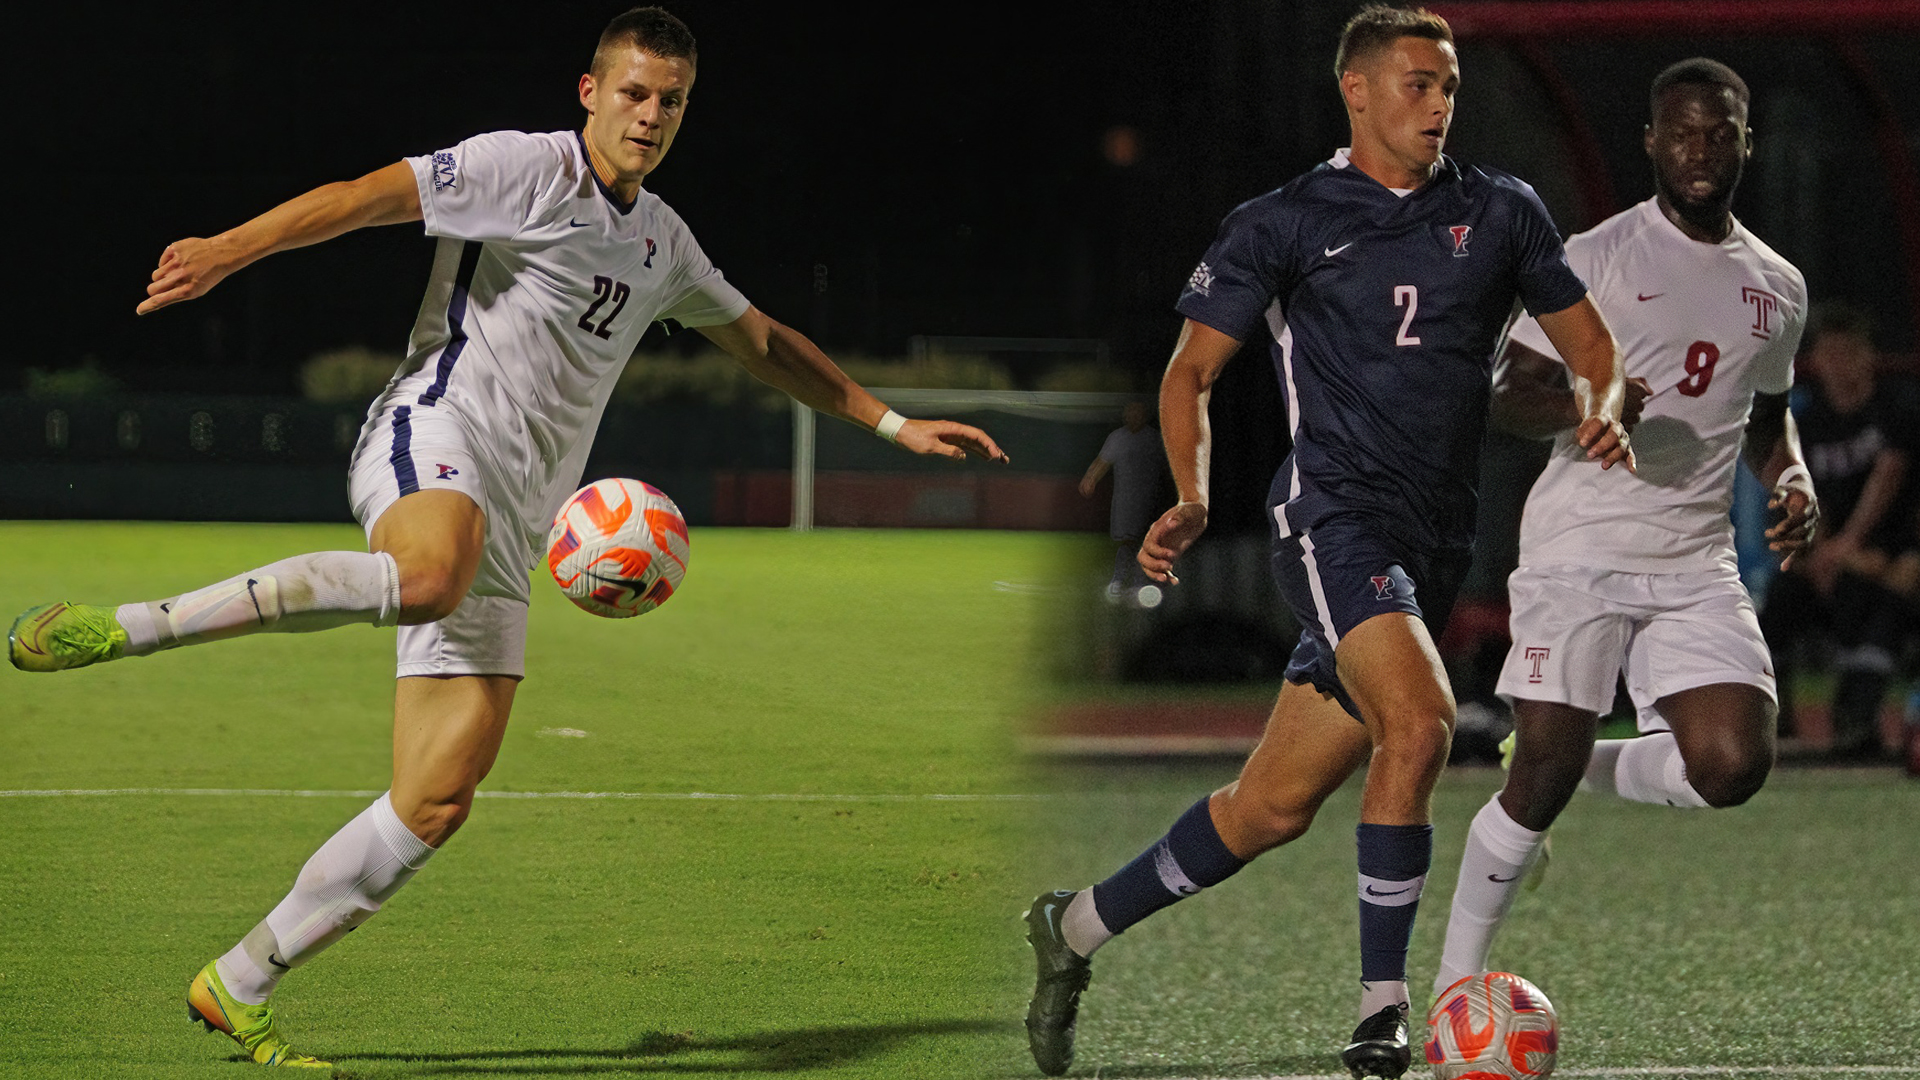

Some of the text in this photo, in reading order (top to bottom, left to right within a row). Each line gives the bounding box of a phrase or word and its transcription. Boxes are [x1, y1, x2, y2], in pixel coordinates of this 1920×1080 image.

[643, 237, 657, 269] P
[1449, 225, 1474, 257] P
[577, 274, 631, 341] 22
[1394, 285, 1421, 346] 2
[1742, 286, 1777, 340] T
[1676, 340, 1720, 398] 9
[1370, 575, 1396, 600] P
[1524, 646, 1551, 683] T
